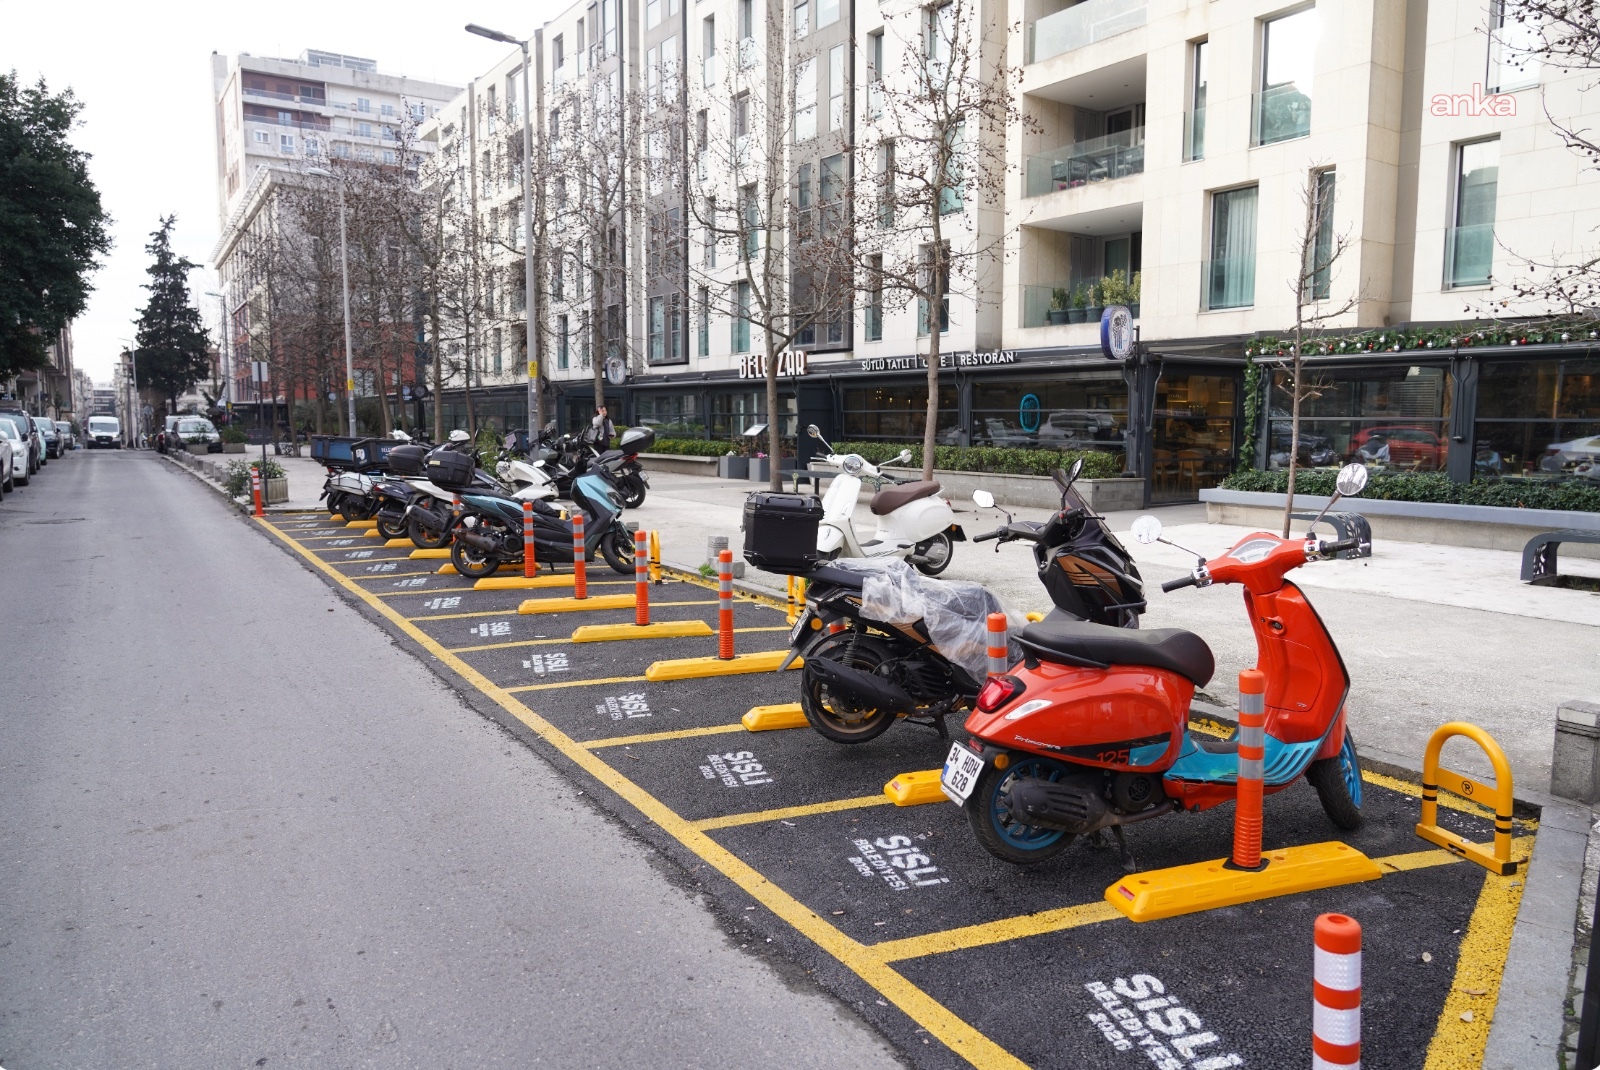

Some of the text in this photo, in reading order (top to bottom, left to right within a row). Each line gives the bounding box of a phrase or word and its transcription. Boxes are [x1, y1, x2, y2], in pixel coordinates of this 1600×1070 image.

[739, 350, 807, 379] BELGZAR
[922, 355, 947, 368] CE
[960, 351, 1014, 366] RESTORAN
[949, 746, 981, 778] 34 HDH
[1097, 748, 1130, 766] 125
[950, 770, 969, 793] 628
